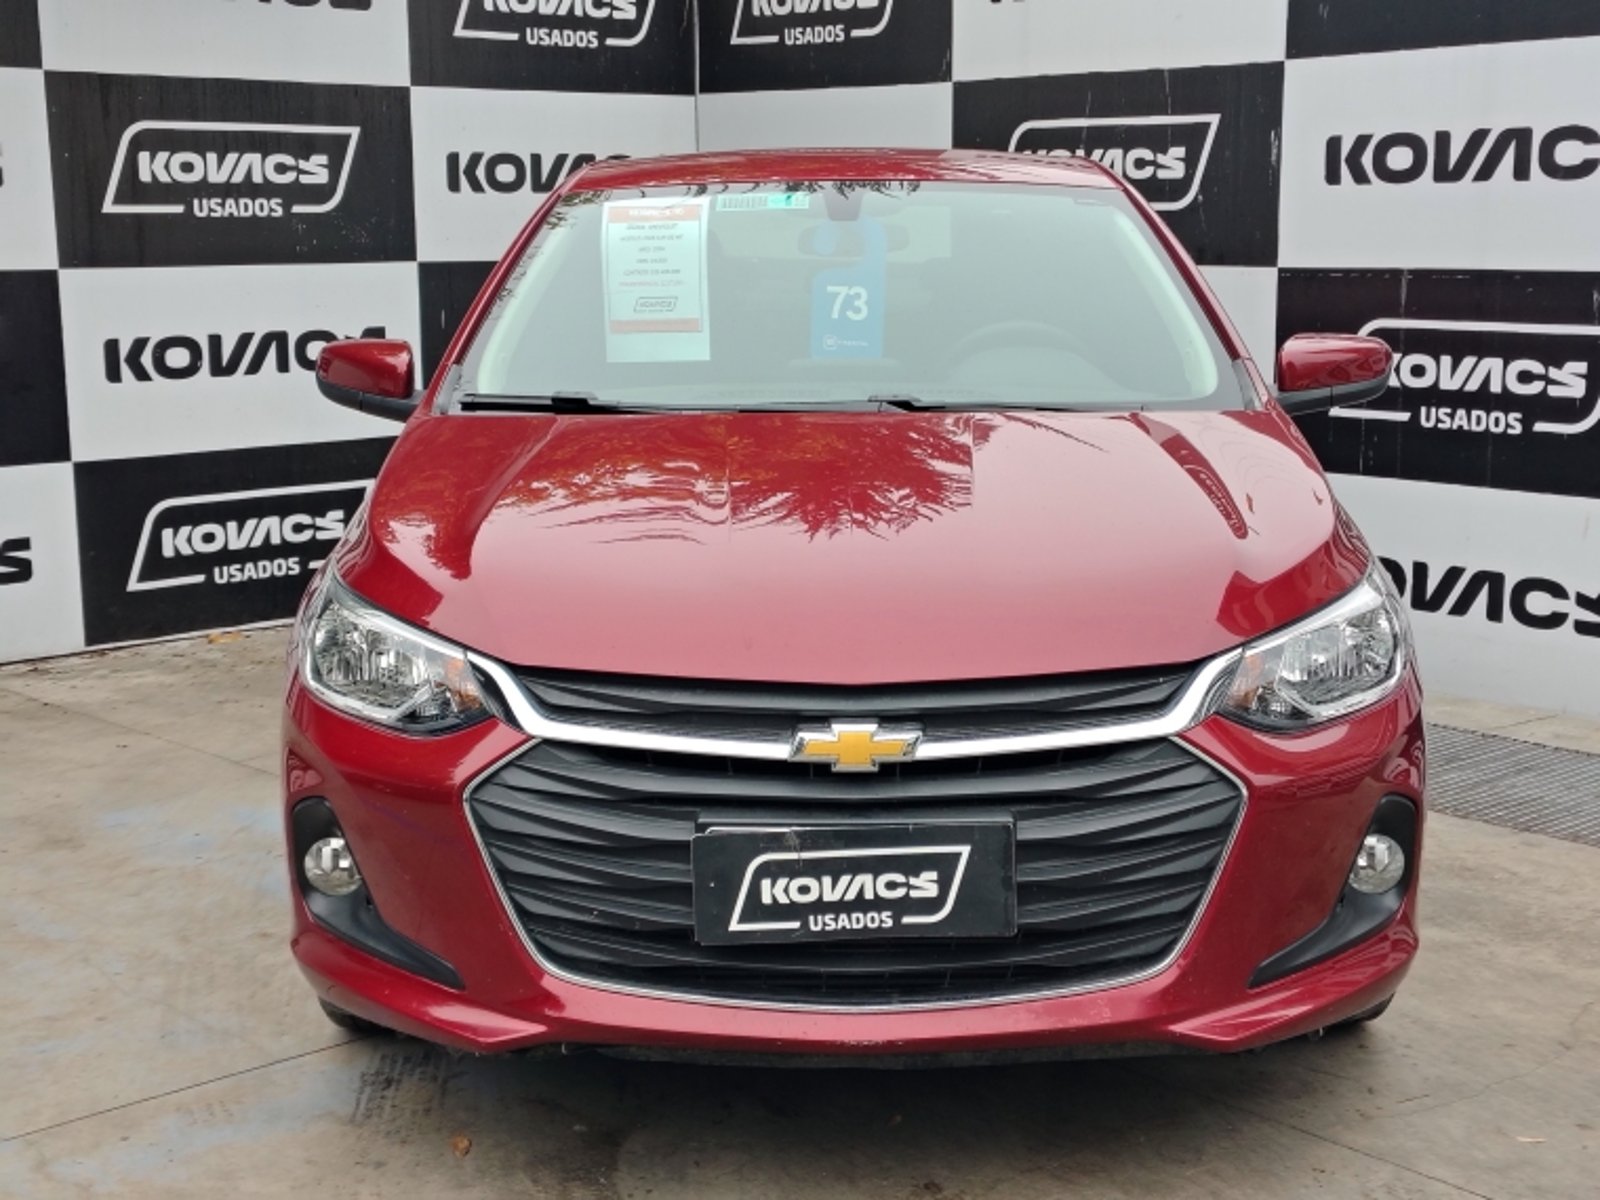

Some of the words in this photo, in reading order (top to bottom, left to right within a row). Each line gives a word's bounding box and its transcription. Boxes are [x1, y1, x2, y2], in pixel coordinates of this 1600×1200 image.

[526, 27, 599, 48] USADOS
[784, 24, 845, 45] USADOS
[138, 151, 330, 184] KOVACS
[446, 151, 631, 193] KOV
[1022, 147, 1186, 180] ACS
[193, 197, 283, 217] USADOS
[826, 286, 868, 320] 73
[103, 326, 386, 383] KOVAC
[1420, 406, 1523, 434] USADOS
[161, 509, 345, 558] KOVACS
[213, 557, 300, 584] USADOS
[760, 871, 939, 904] KOVACS
[808, 911, 893, 931] USADOS
